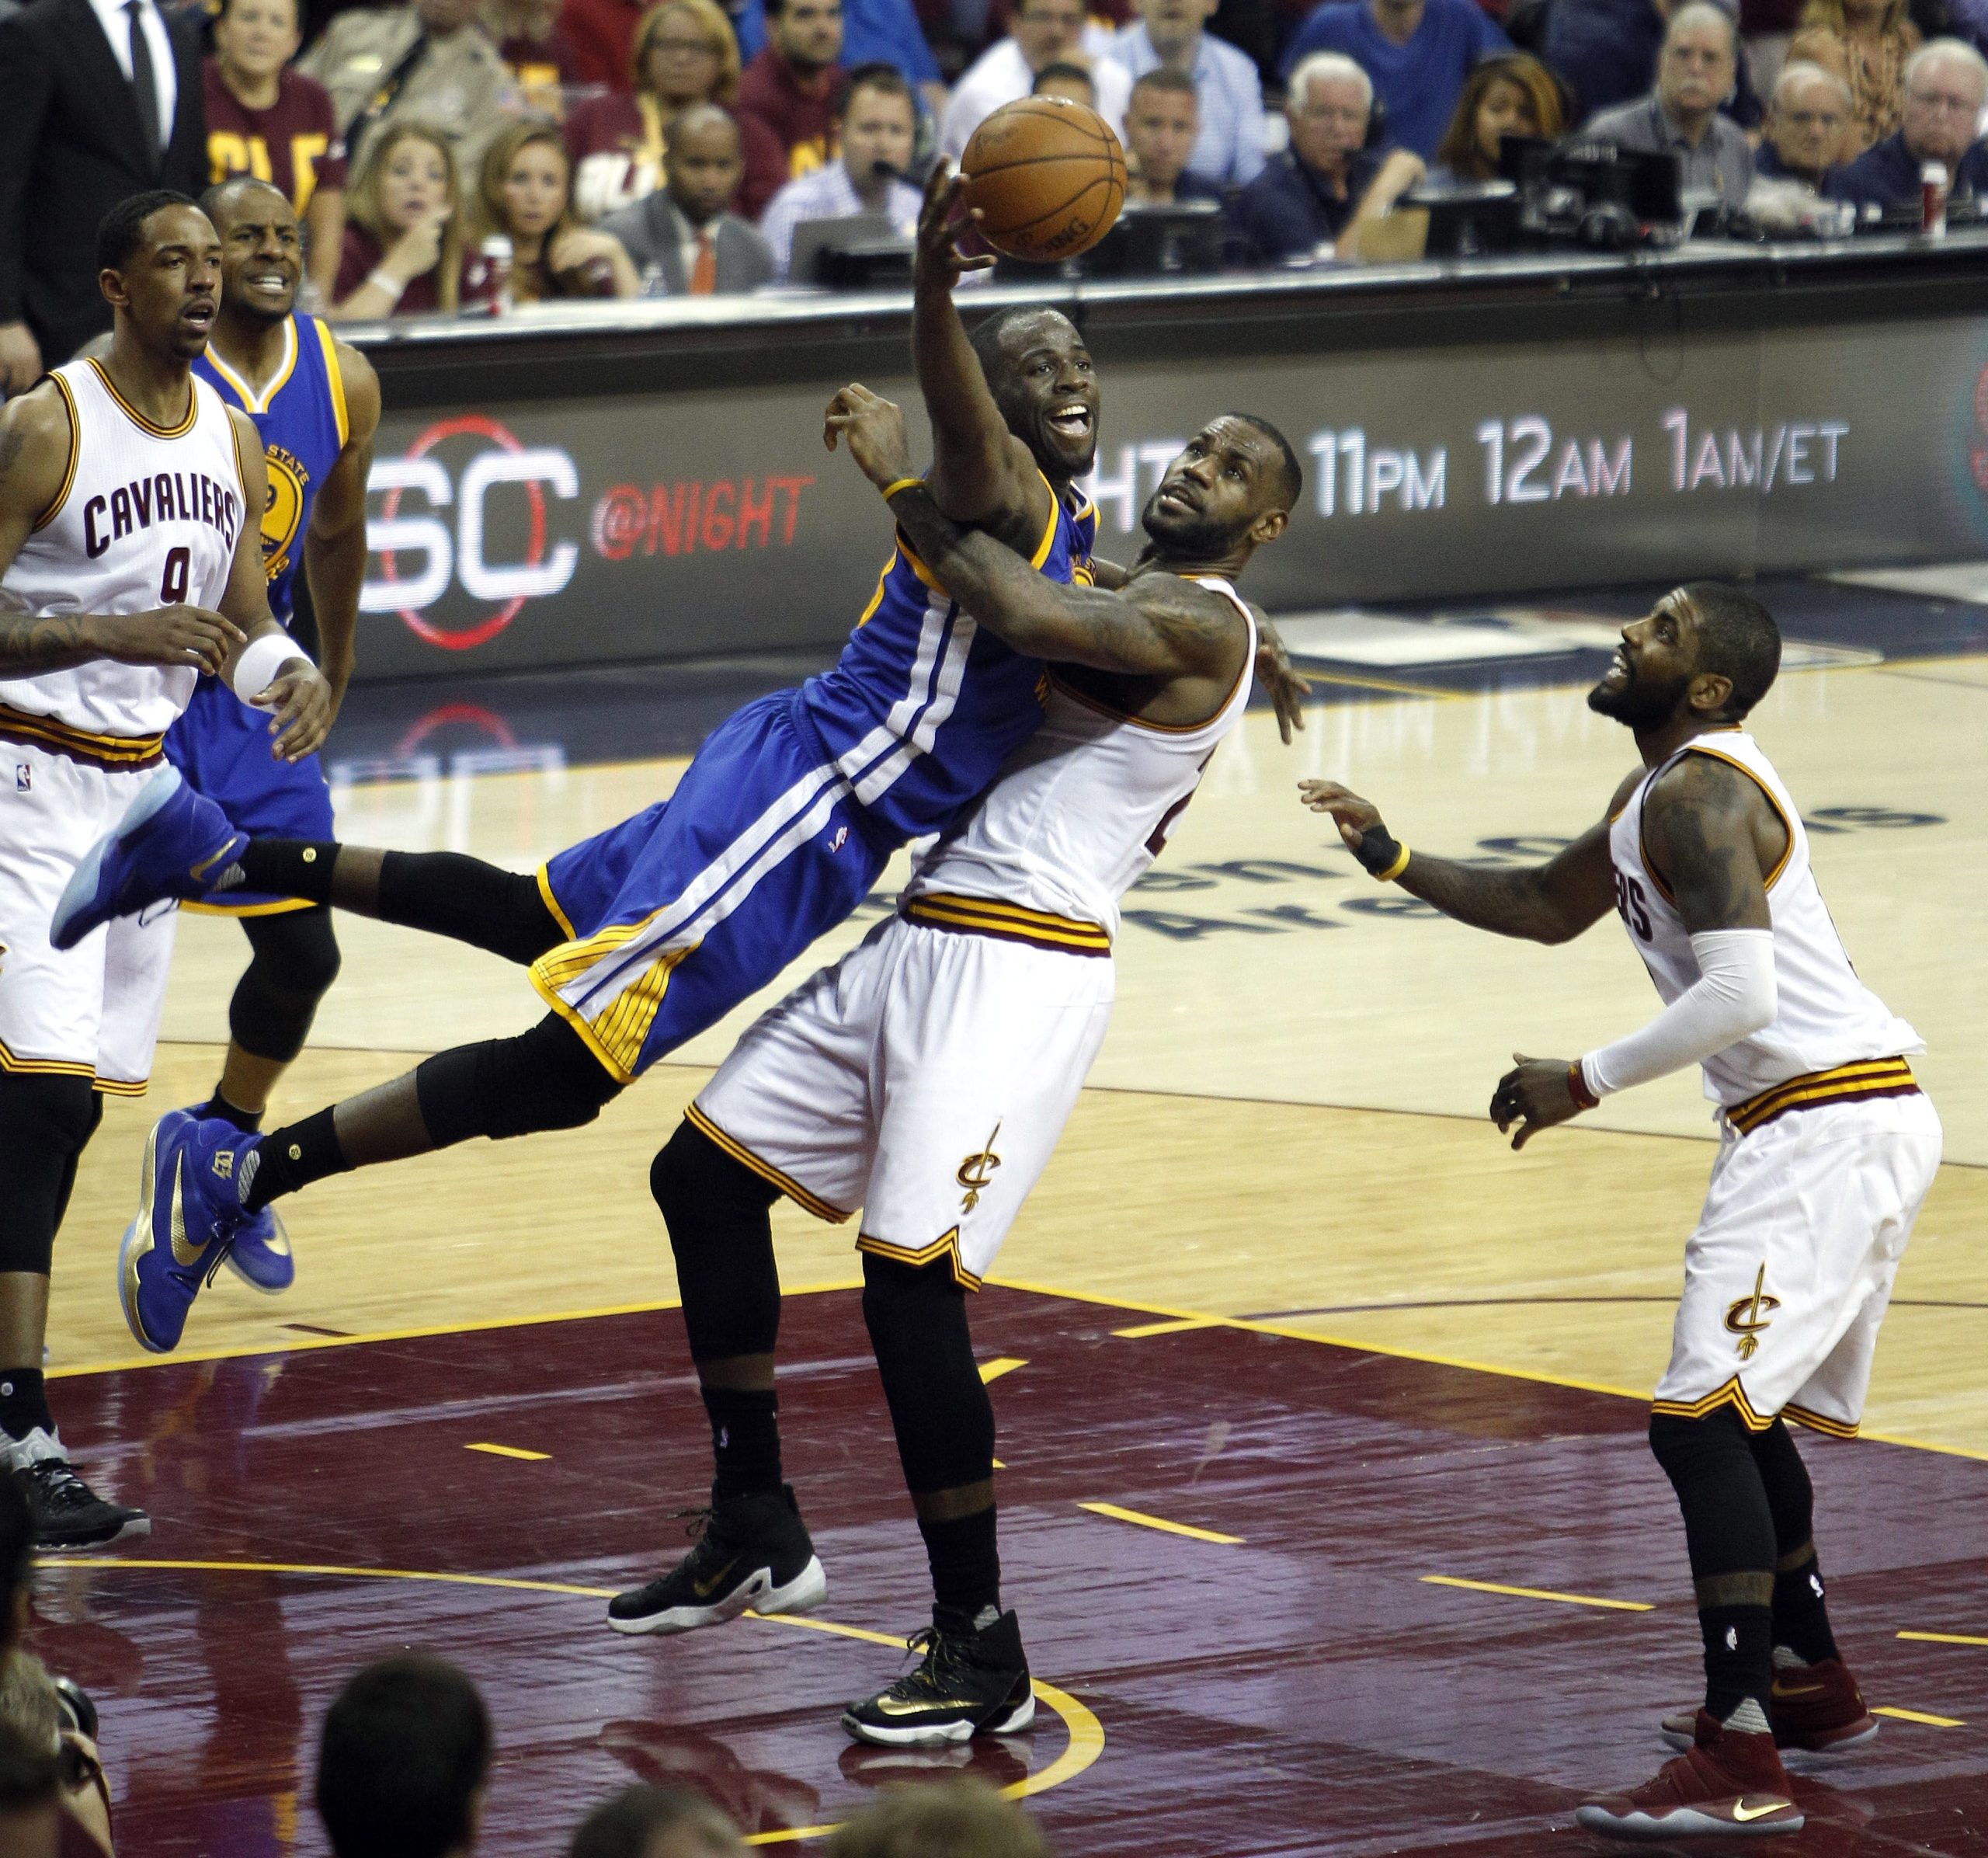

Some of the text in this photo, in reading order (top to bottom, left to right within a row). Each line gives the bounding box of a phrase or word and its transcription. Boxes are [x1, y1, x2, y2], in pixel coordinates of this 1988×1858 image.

[266, 444, 310, 487] STATE
[591, 475, 816, 561] @NIGHT
[1309, 429, 1449, 517] 11PM
[1474, 413, 1633, 505] 12AM
[1660, 405, 1851, 495] 1AM/ET
[83, 471, 237, 561] CAVALIERS
